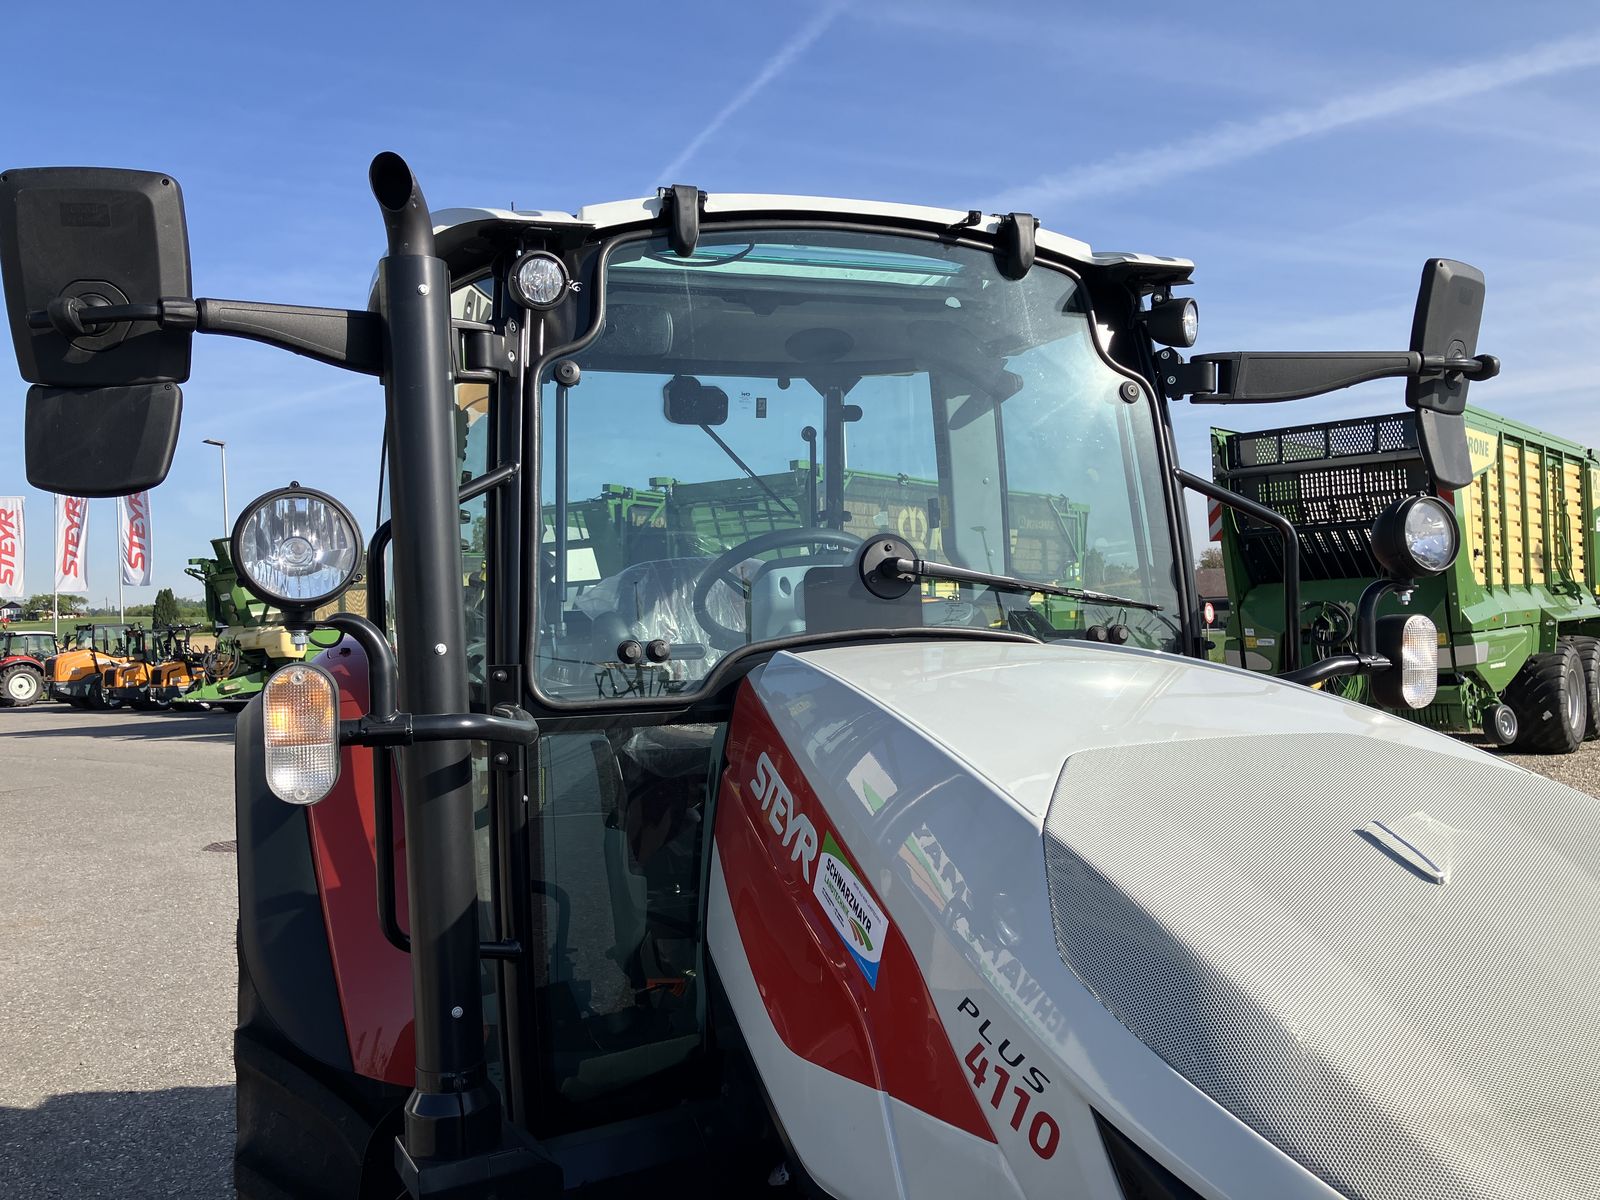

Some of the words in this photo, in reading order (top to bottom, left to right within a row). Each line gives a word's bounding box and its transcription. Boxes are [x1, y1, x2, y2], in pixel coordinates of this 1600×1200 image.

[1468, 436, 1489, 457] RONE
[62, 496, 81, 577] STEYR
[749, 751, 819, 884] STEYR
[824, 874, 849, 918] LANDTECHNIK
[826, 858, 872, 934] SCHWARZMAYR
[957, 996, 1051, 1094] PLUS
[964, 1042, 1061, 1160] 4110
